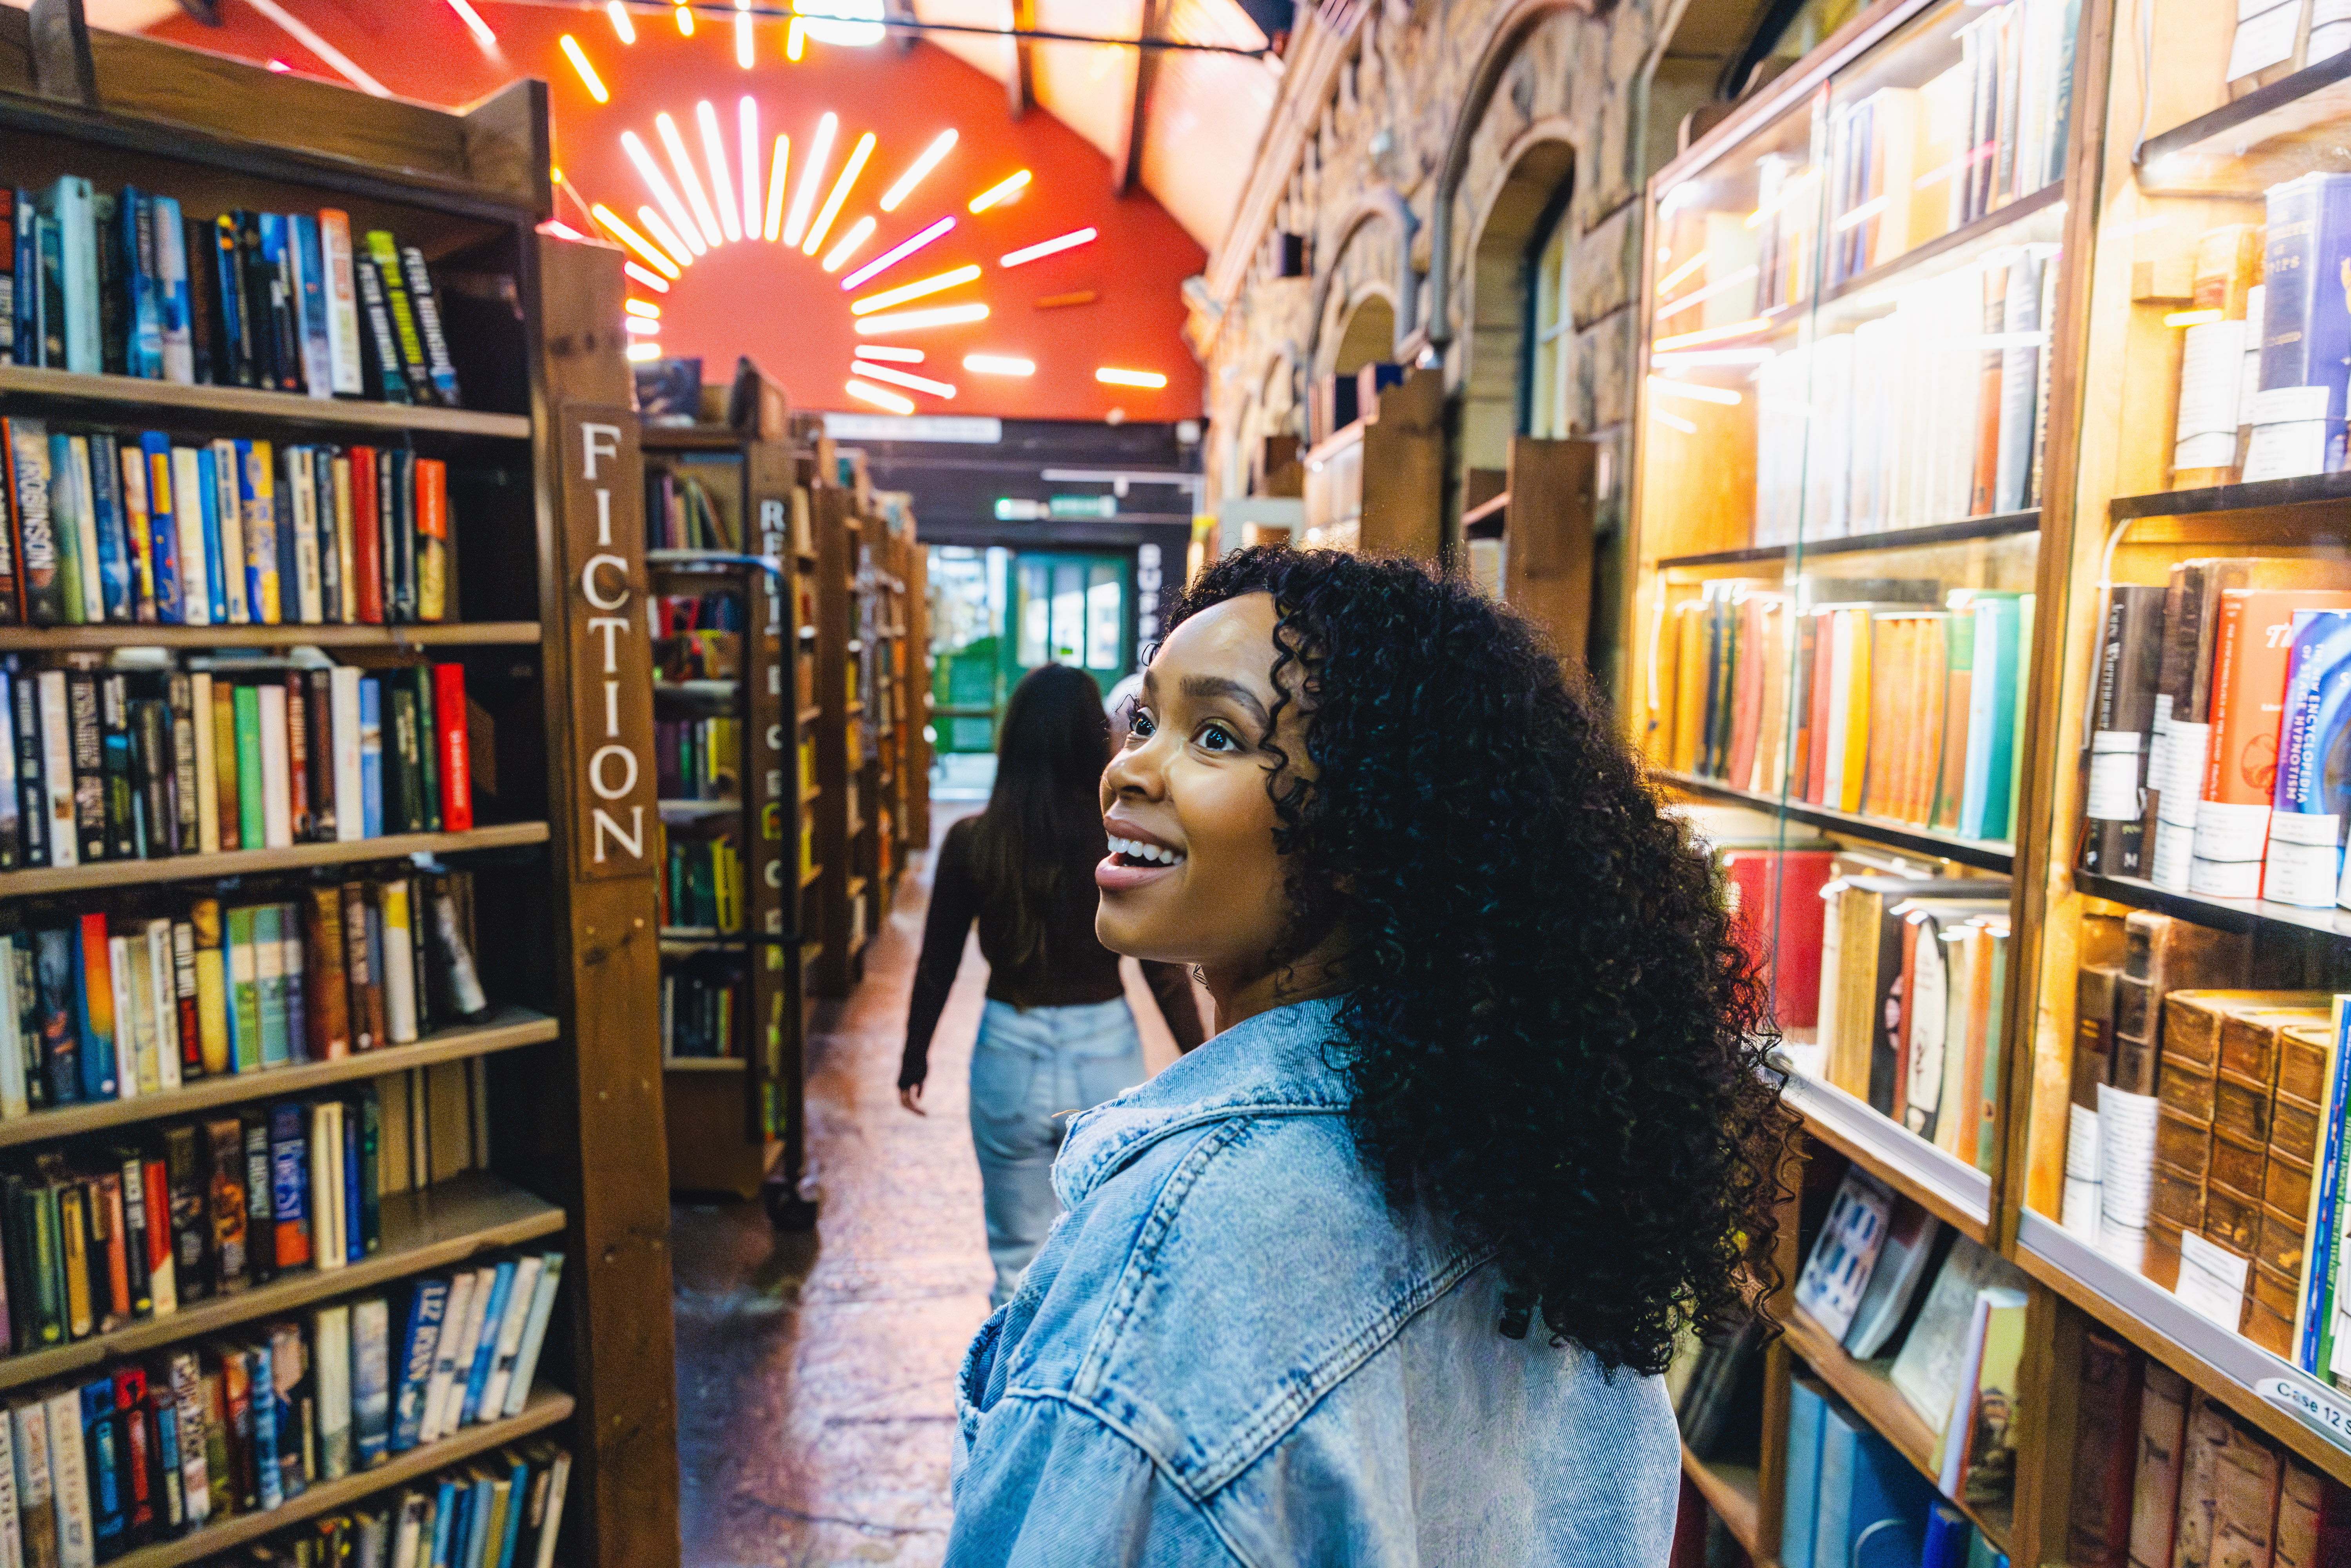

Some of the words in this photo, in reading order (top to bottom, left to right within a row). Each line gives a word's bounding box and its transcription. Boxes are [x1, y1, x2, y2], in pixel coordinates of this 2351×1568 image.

[581, 422, 643, 863] FICTION
[2297, 664, 2311, 710] STAGE
[2286, 715, 2305, 800] HYPNOTISM
[2297, 695, 2321, 804] ENCYCLOPEDIA
[2277, 1381, 2318, 1413] Case
[2324, 1406, 2342, 1427] 12
